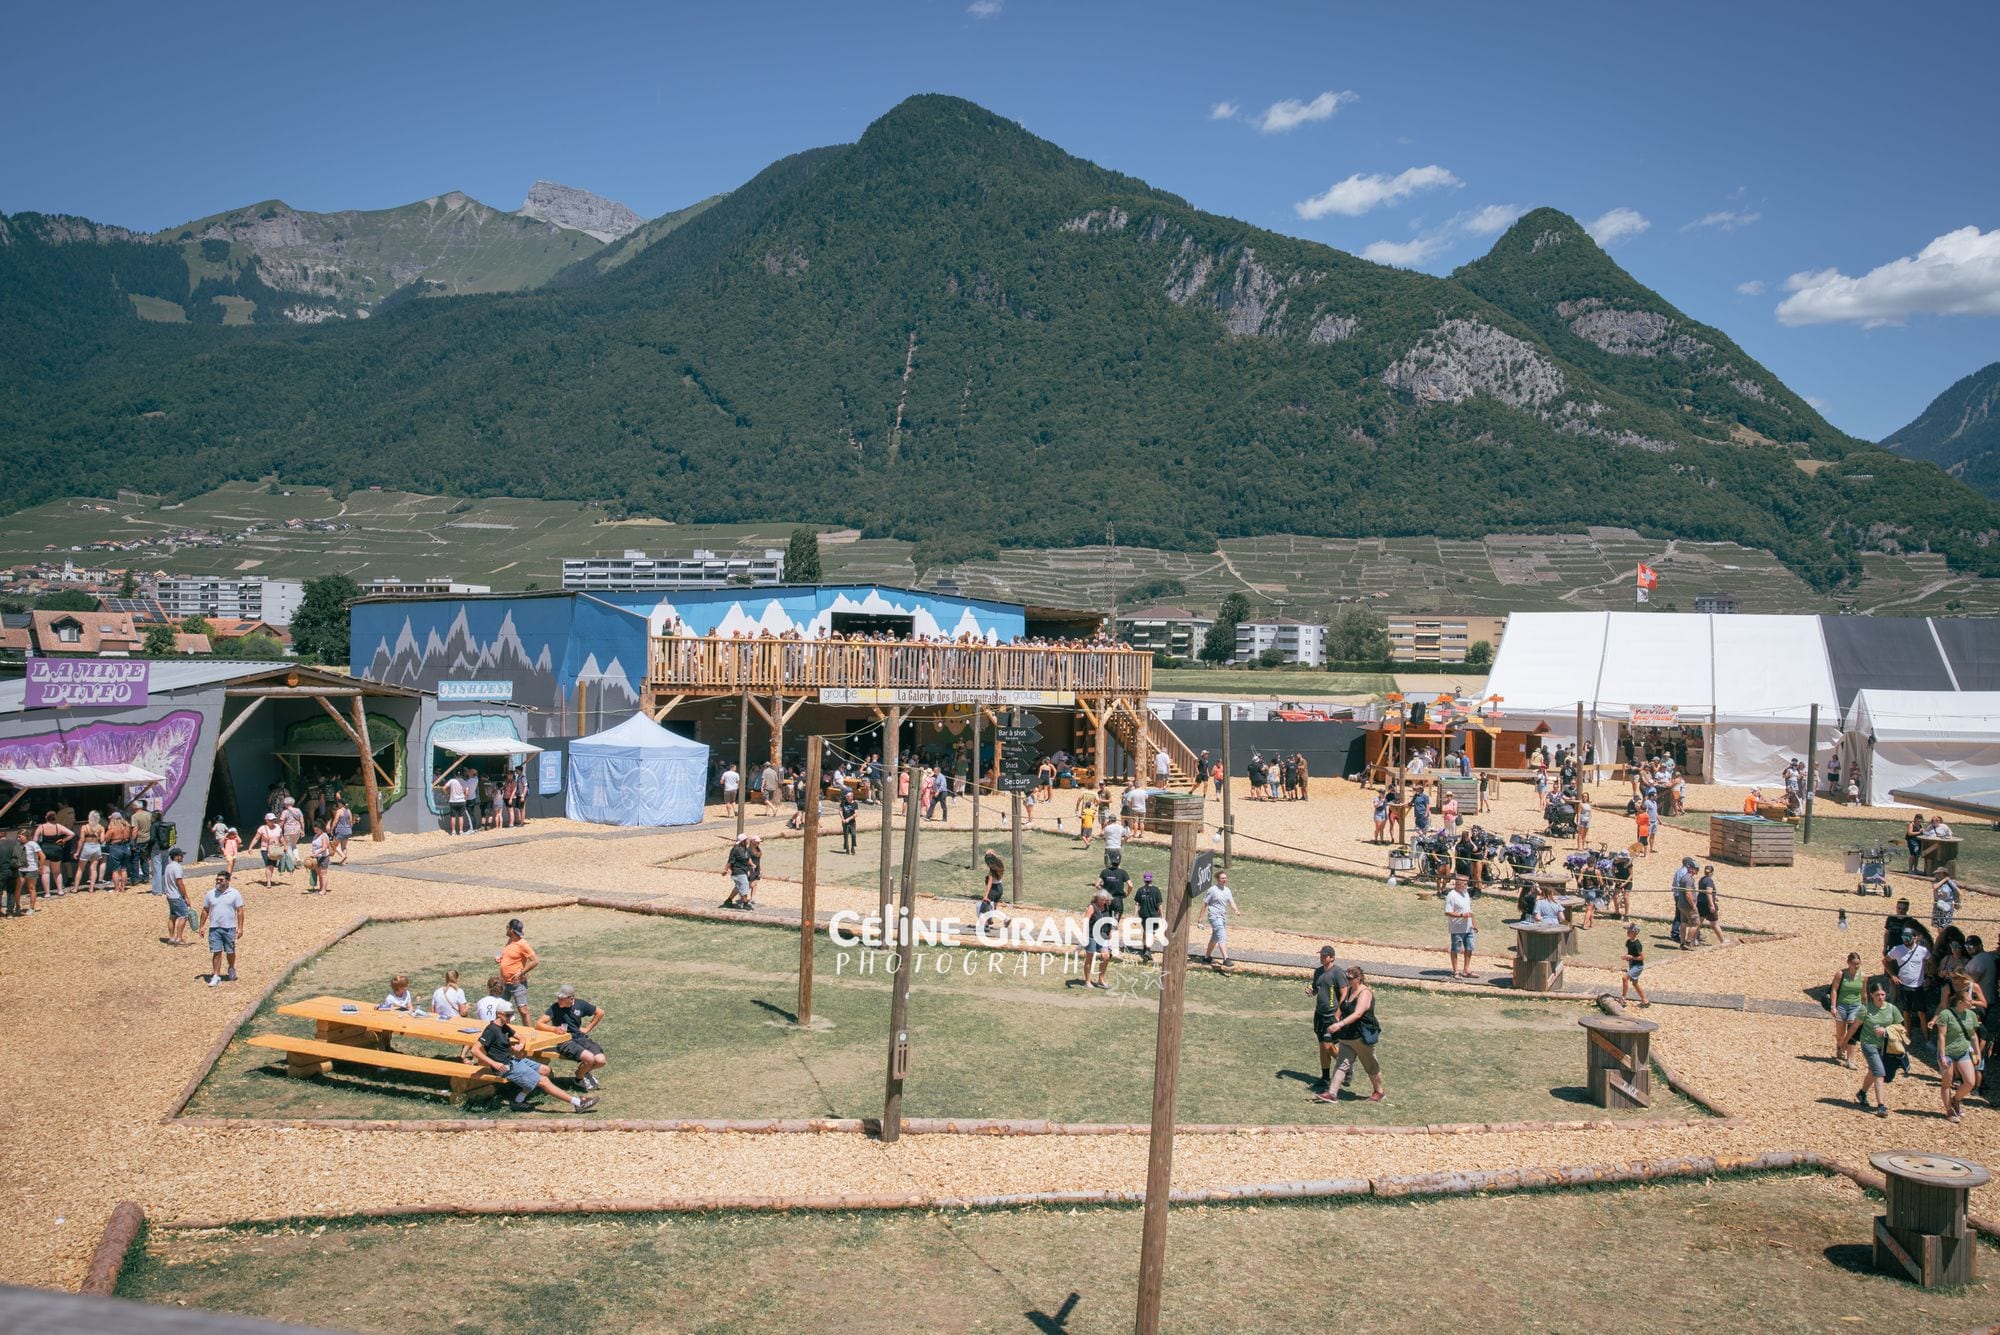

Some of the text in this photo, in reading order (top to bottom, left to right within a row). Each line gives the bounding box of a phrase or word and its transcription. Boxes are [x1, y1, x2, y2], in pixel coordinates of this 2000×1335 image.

[41, 683, 132, 704] D'INFO
[439, 682, 512, 697] CASHLESS
[897, 690, 906, 701] La
[908, 690, 935, 702] Galerie
[936, 690, 950, 702] des
[1013, 729, 1027, 737] shot
[1004, 778, 1031, 786] Secours
